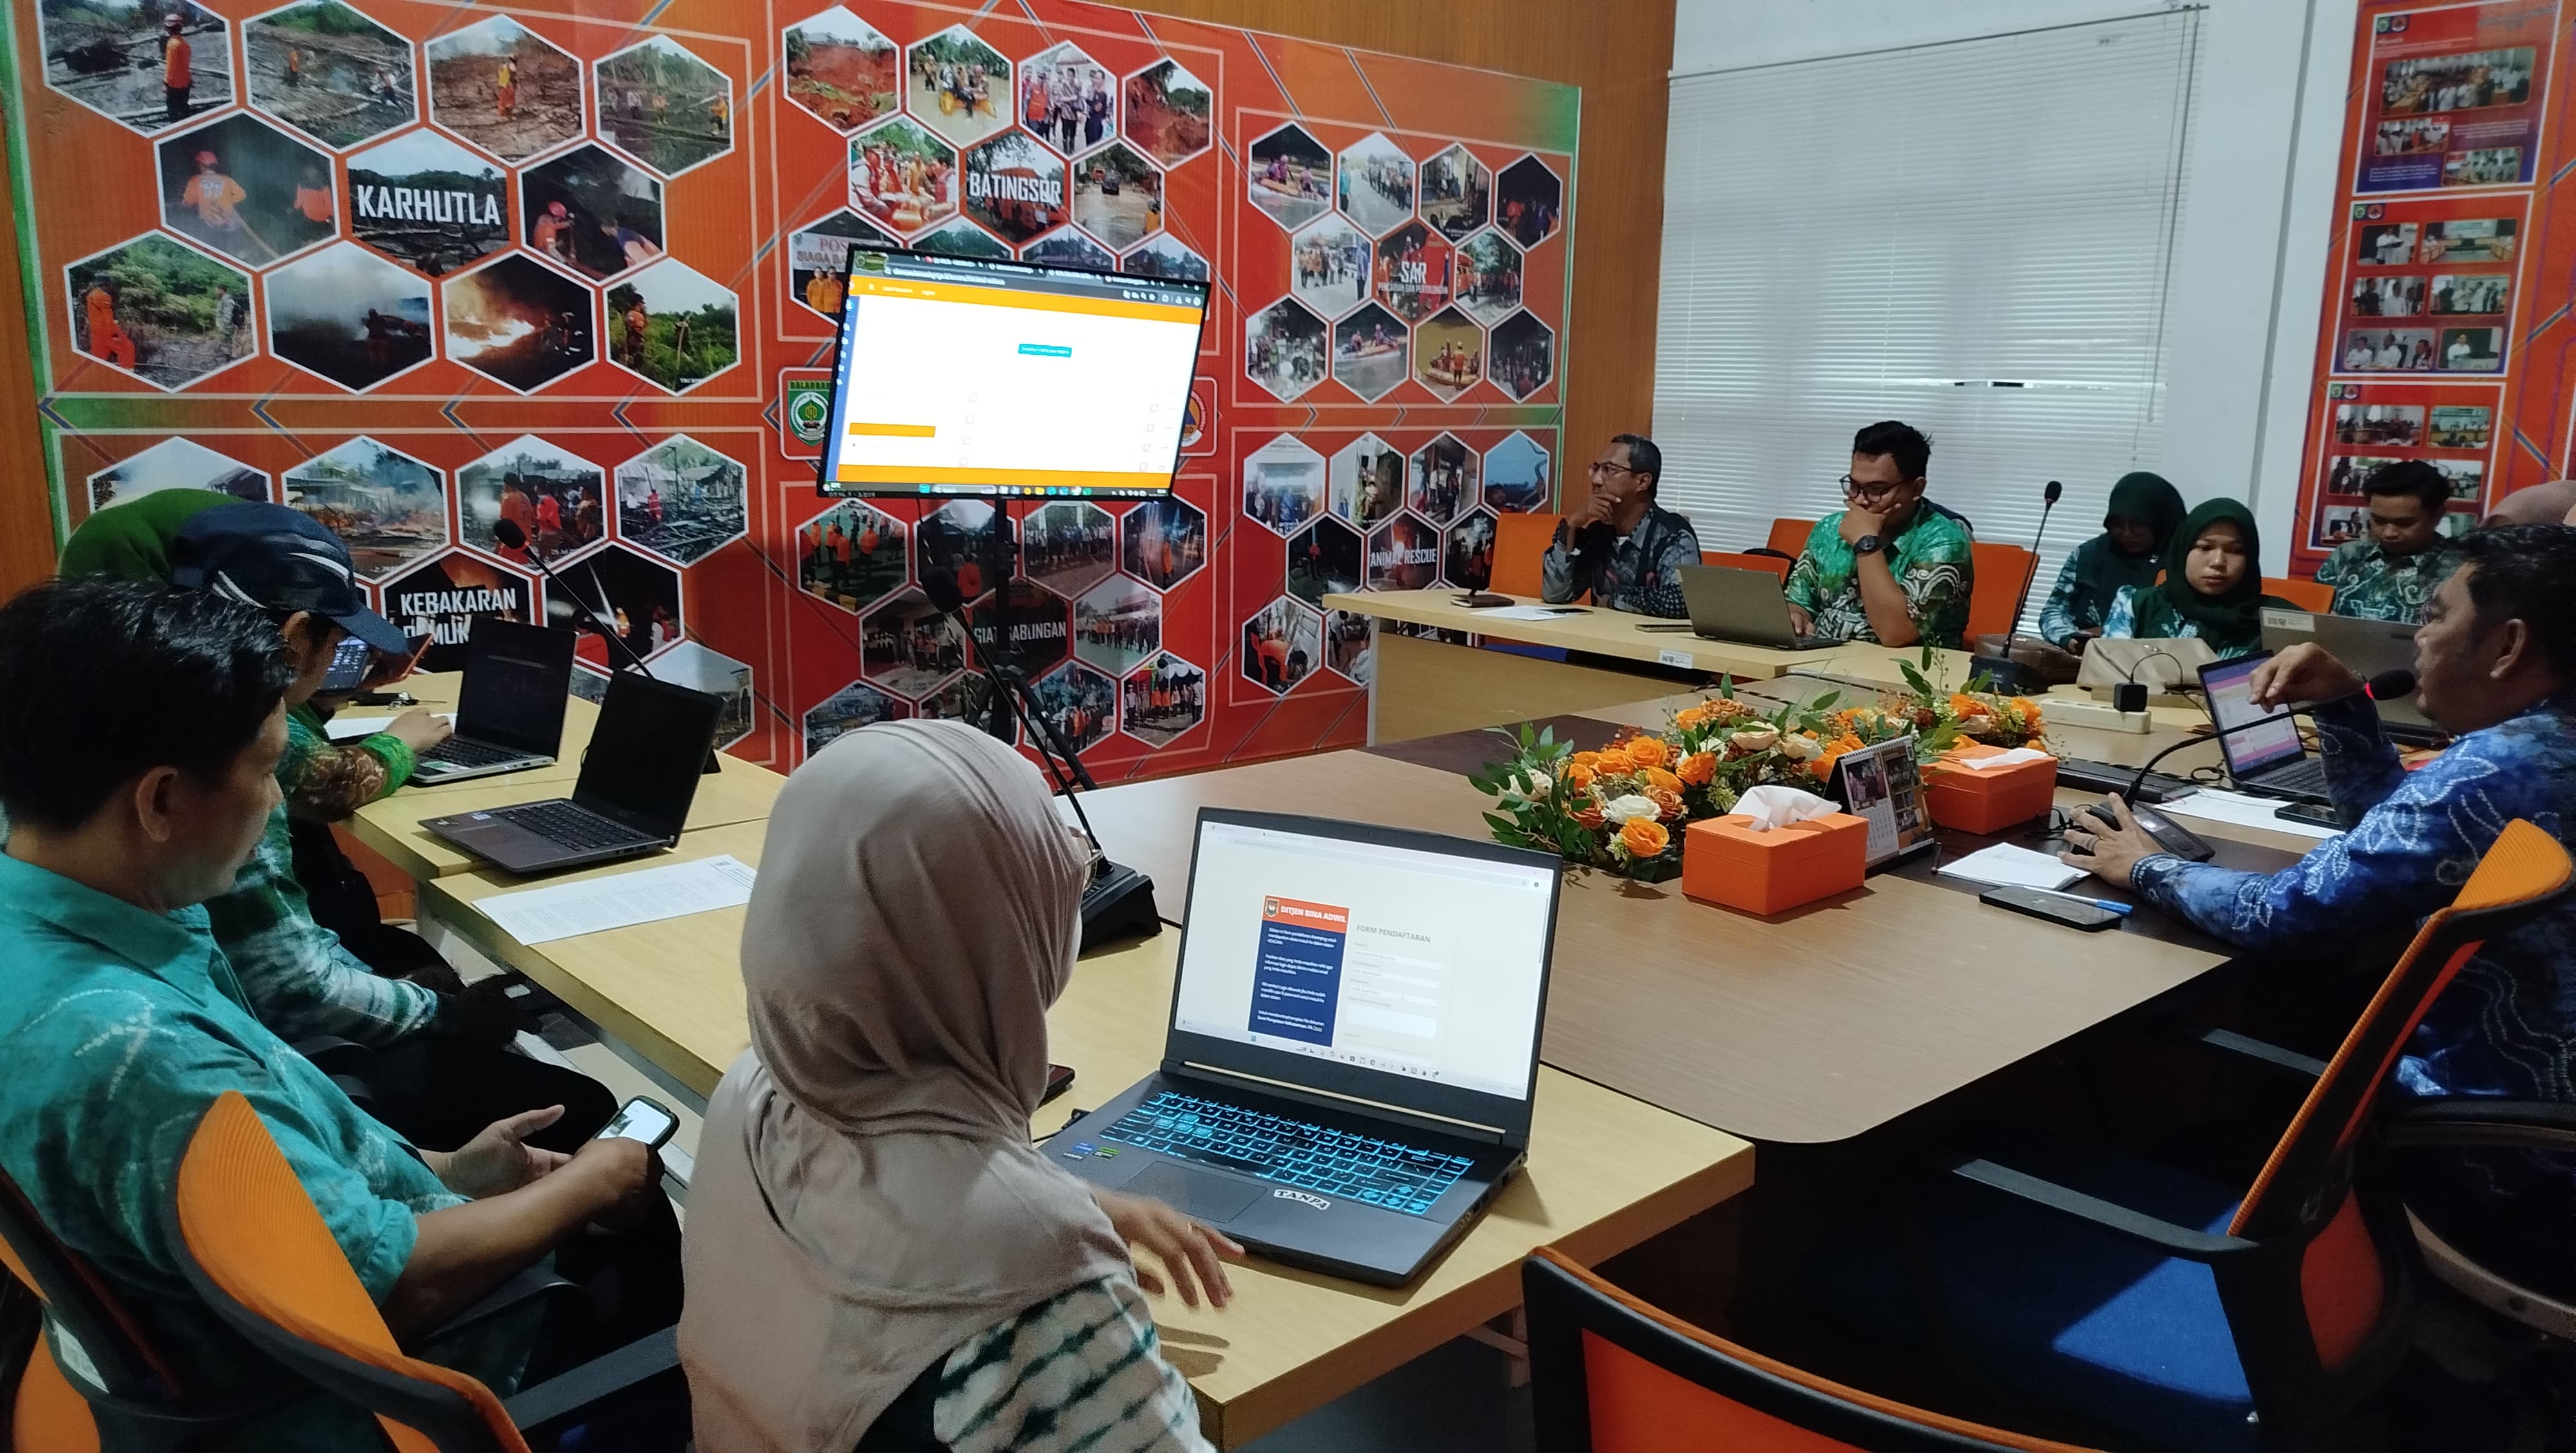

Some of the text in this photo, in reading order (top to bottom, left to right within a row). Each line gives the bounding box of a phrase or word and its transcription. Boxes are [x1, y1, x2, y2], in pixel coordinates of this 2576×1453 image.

[357, 184, 502, 225] KARHUTLA
[1401, 261, 1426, 284] SAR
[1370, 548, 1437, 567] ANIMAL RESCUE
[401, 587, 516, 616] KEBAKARAN
[1009, 621, 1066, 641] ABUNGAN
[1280, 906, 1347, 923] DITJEN BINA ADWIL
[1356, 924, 1431, 943] FORM PENDAFTARAN
[1276, 1190, 1328, 1208] TANPA
